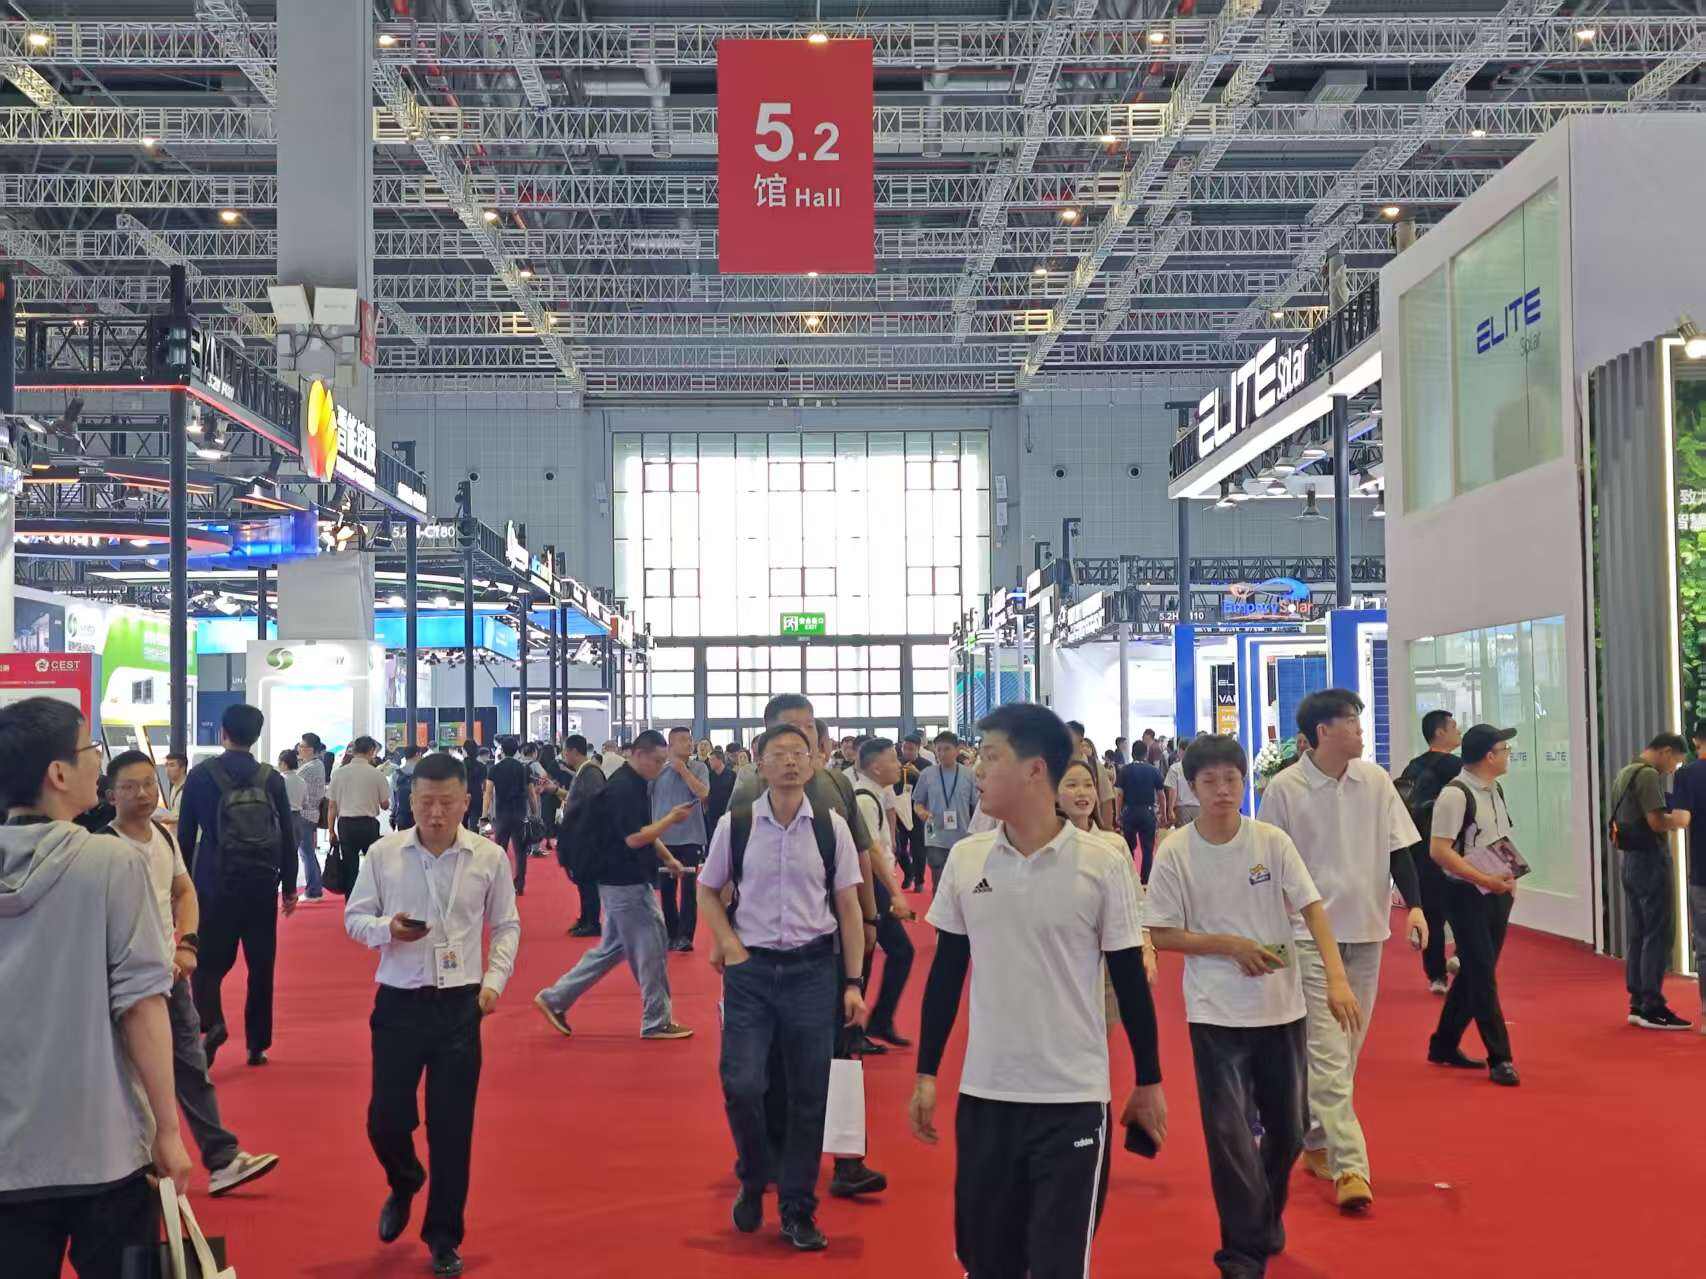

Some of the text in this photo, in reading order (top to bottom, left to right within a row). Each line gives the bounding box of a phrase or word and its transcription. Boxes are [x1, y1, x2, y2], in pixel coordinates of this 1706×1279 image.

[754, 102, 840, 162] 5.2
[754, 172, 787, 207] 馆
[795, 188, 841, 208] Hall
[1477, 287, 1541, 354] ELITE
[1199, 337, 1276, 458] ELITE
[1280, 598, 1313, 614] Solar
